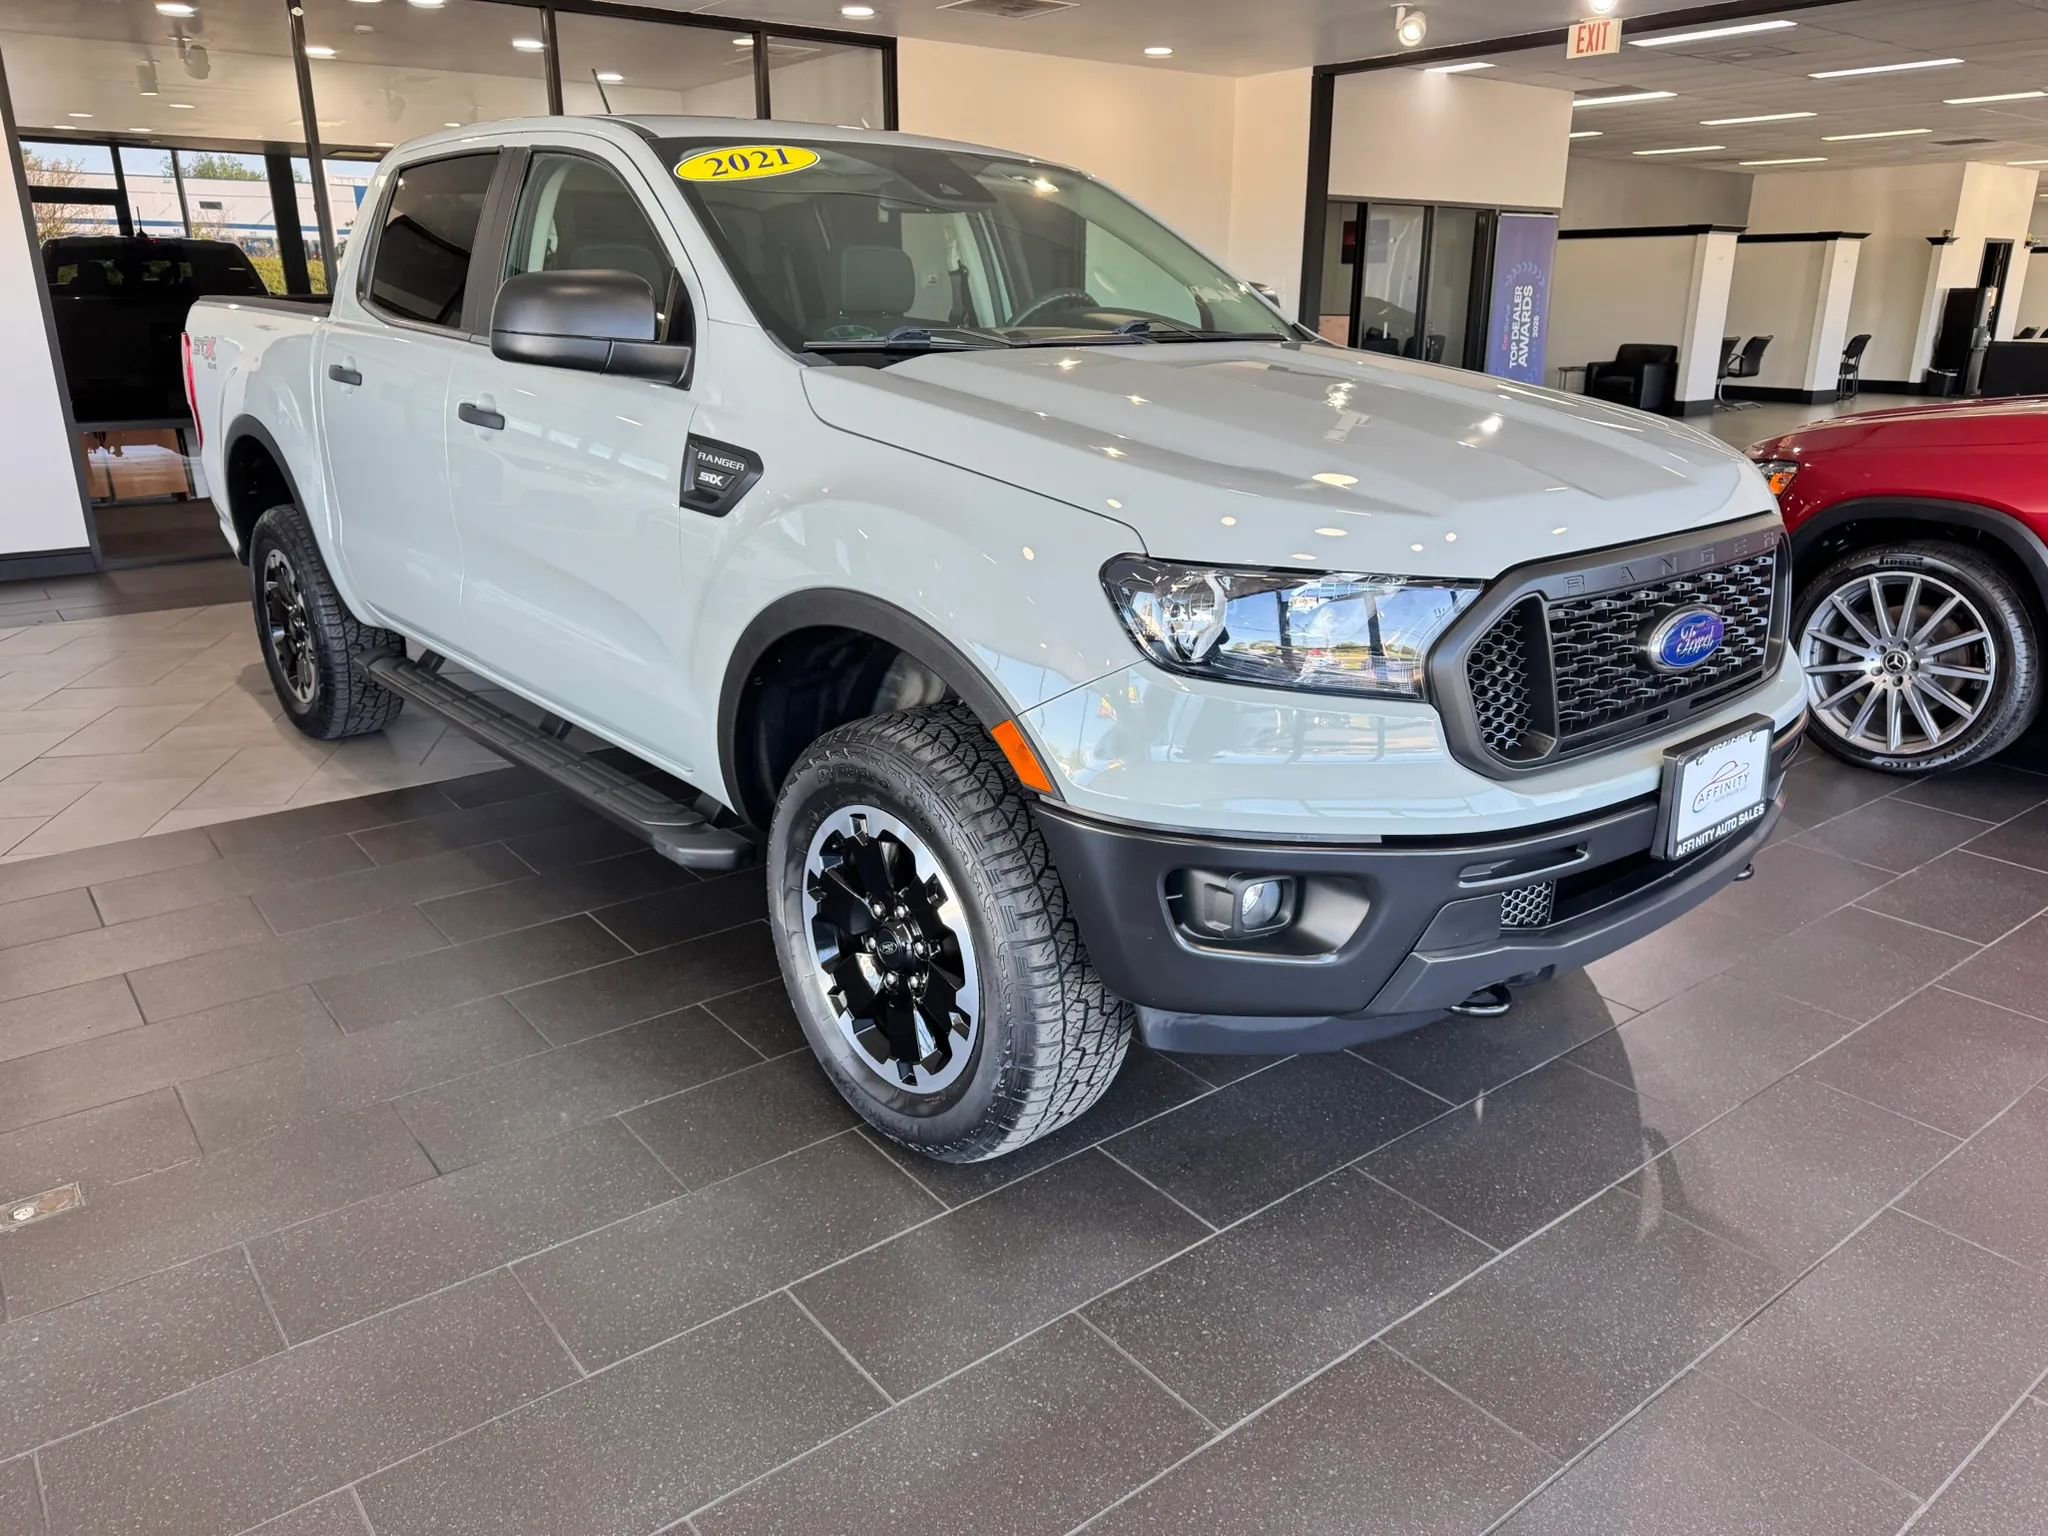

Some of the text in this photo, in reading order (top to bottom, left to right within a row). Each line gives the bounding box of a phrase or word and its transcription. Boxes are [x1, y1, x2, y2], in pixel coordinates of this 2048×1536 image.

[1576, 21, 1611, 54] EXIT
[704, 148, 792, 177] 2021
[1509, 285, 1523, 369] TOP DEALER
[1518, 284, 1533, 367] AWARDS
[697, 451, 745, 472] RANGER
[697, 471, 725, 487] STX
[1563, 531, 1775, 595] RANGER
[1676, 620, 1716, 658] Ford
[1881, 757, 1938, 769] ZERO
[1697, 772, 1750, 805] AFFINITY
[1676, 803, 1766, 857] AFFINITY AUTO SALES
